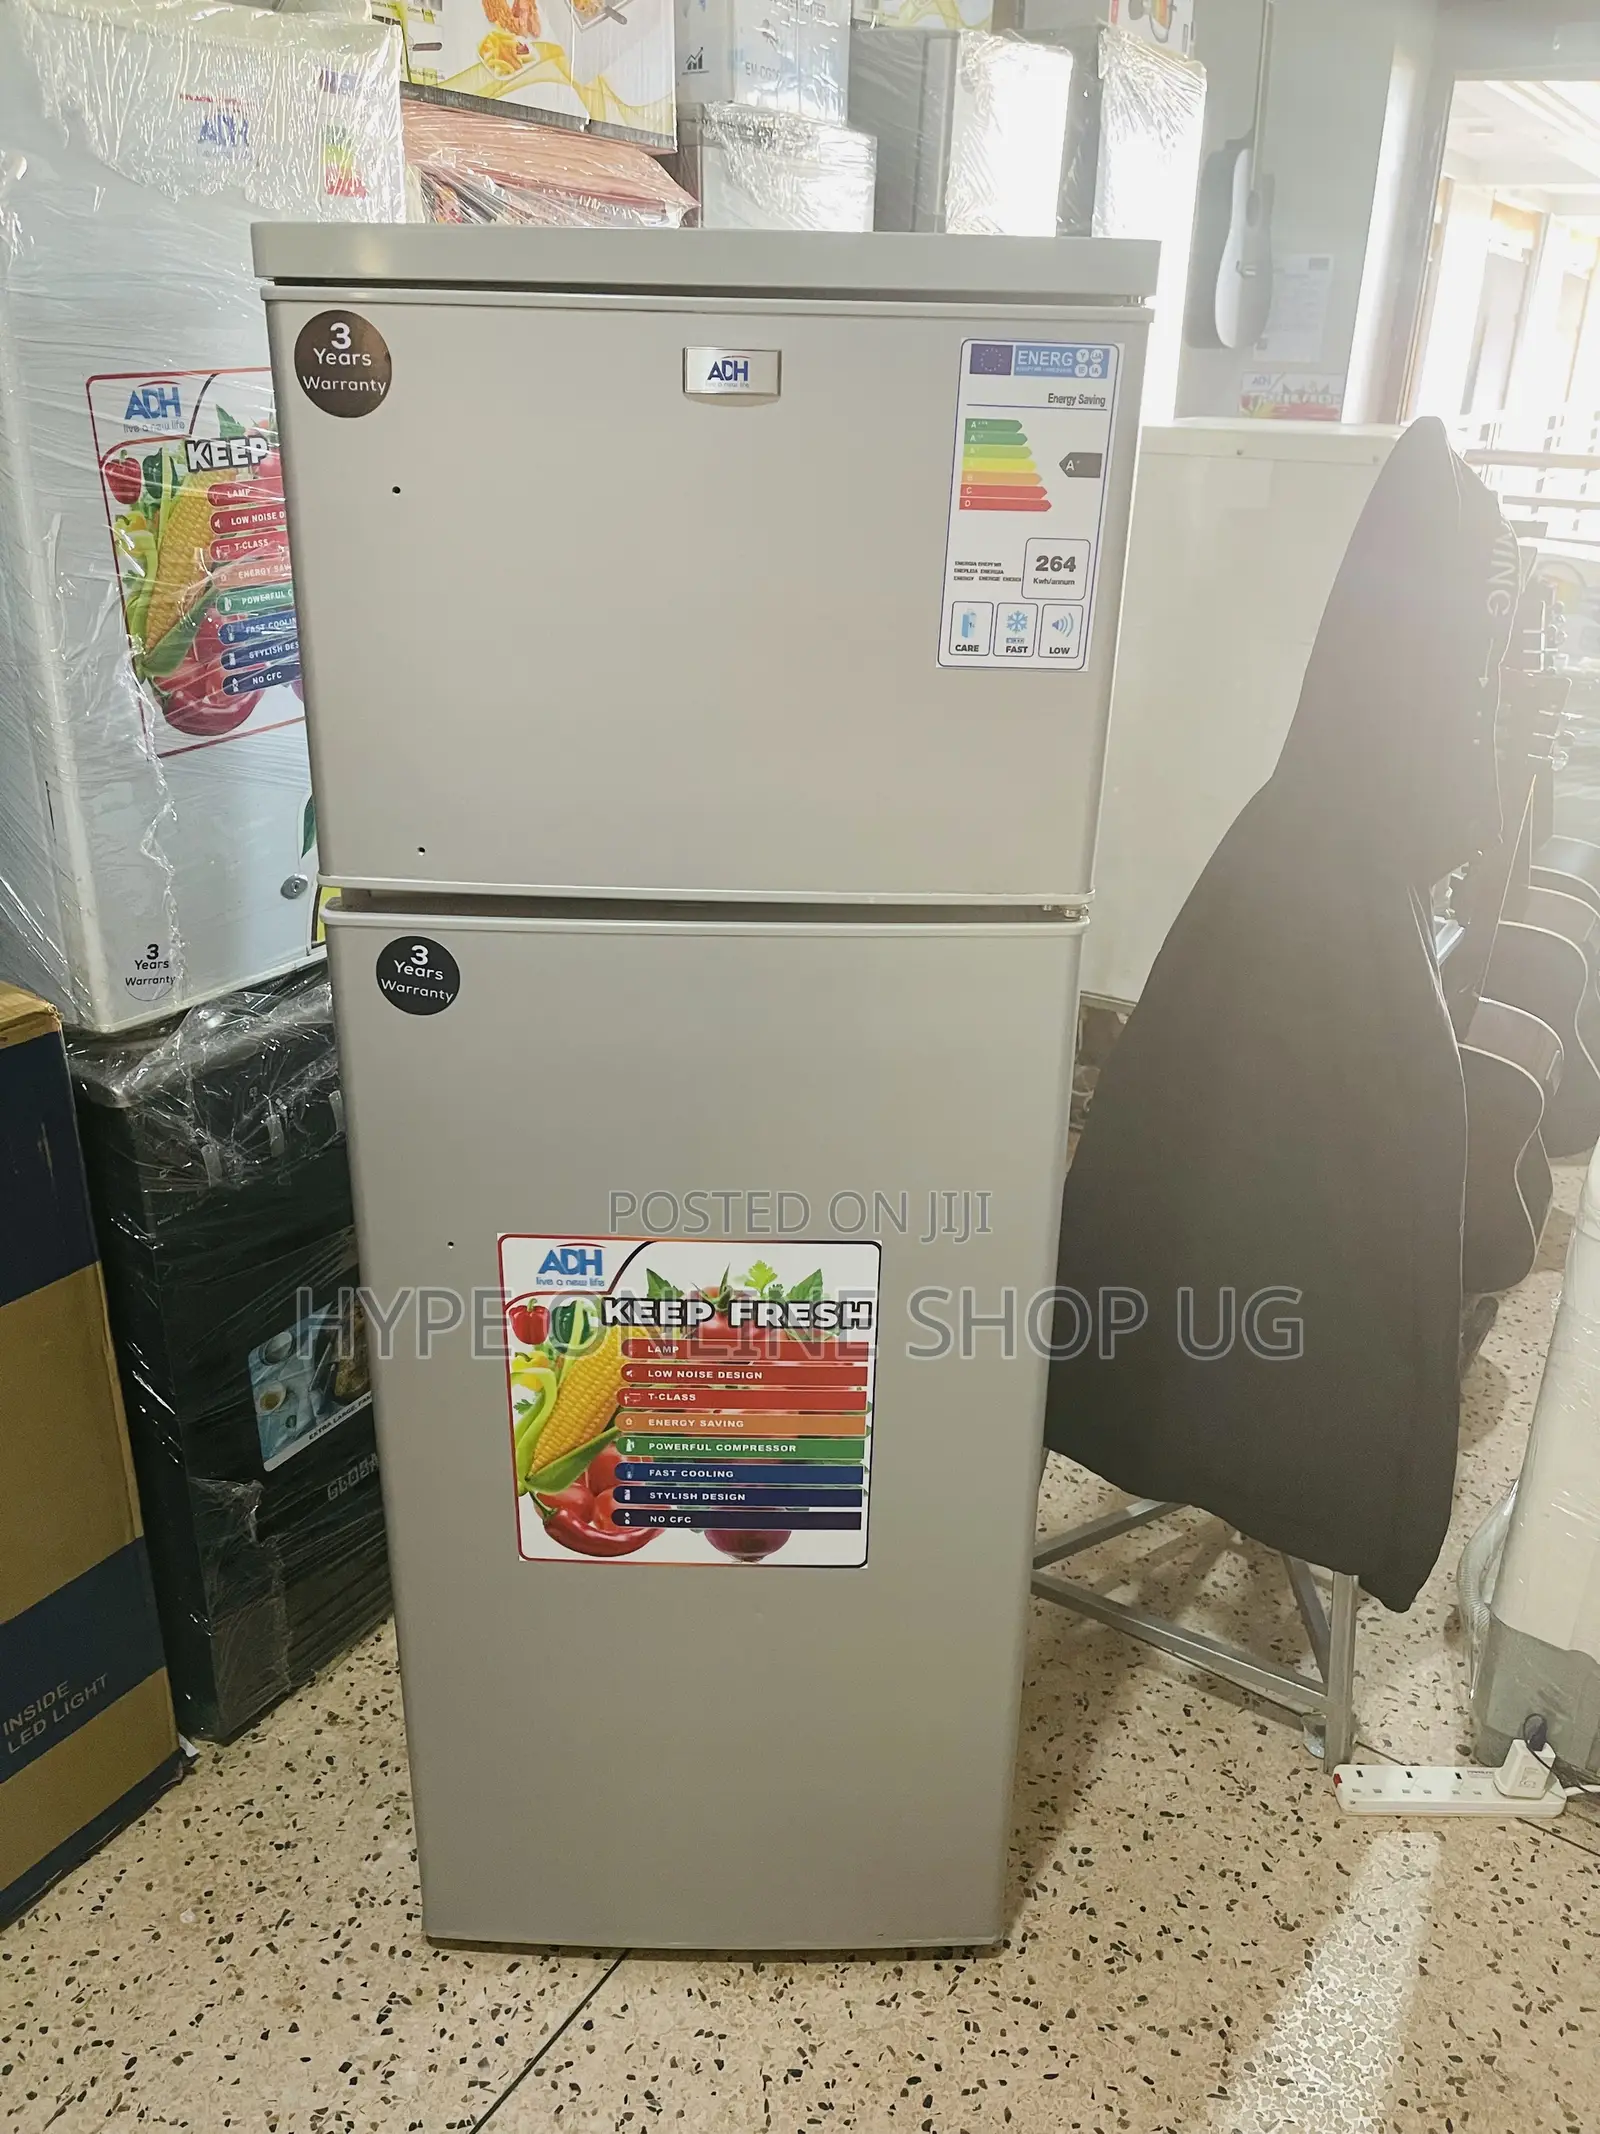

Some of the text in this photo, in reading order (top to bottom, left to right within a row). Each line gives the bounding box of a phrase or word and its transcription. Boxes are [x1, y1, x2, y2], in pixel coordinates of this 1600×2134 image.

[330, 321, 352, 350] 3
[313, 347, 372, 366] Years
[1017, 350, 1074, 367] ENERG
[707, 360, 749, 381] ADH
[303, 375, 387, 396] Warranty
[124, 386, 182, 420] ADH
[1048, 393, 1106, 407] Energy Saving
[184, 435, 270, 473] KEEP
[227, 488, 251, 498] LAMP
[231, 516, 250, 526] LOW
[251, 511, 278, 523] NOISE
[234, 538, 270, 552] T-CLASS
[1035, 555, 1077, 573] 264
[238, 567, 271, 580] ENERGY
[1033, 577, 1075, 586] Kwh/annum
[242, 590, 287, 605] POWERFUL
[245, 623, 265, 634] FAST
[249, 643, 283, 659] STYLISH
[955, 644, 1070, 655] CARE FAST LOW
[252, 671, 282, 684] NO CFC
[146, 943, 159, 960] 3
[410, 944, 429, 965] 3
[134, 959, 170, 970] Years
[394, 960, 444, 980] Years
[125, 976, 176, 986] Warranty
[381, 978, 454, 1003] Warranty
[537, 1248, 603, 1276] ADH
[536, 1277, 553, 1286] live
[589, 1277, 605, 1287] life
[601, 1297, 873, 1331] KEEP FRESH
[647, 1345, 680, 1354] LAMP
[648, 1370, 763, 1380] LOW NOISE DESIGN
[648, 1392, 697, 1402] T-CLASS
[648, 1418, 745, 1428] ENERGY SAVING
[649, 1442, 797, 1452] POWERFUL COMPRESSOR
[649, 1469, 734, 1478] FAST COOLING
[649, 1491, 746, 1501] STYLISH DESIGN
[650, 1515, 692, 1524] NO CFC
[3, 1680, 71, 1736] INSIDE
[8, 1671, 109, 1754] LED LIGHT
